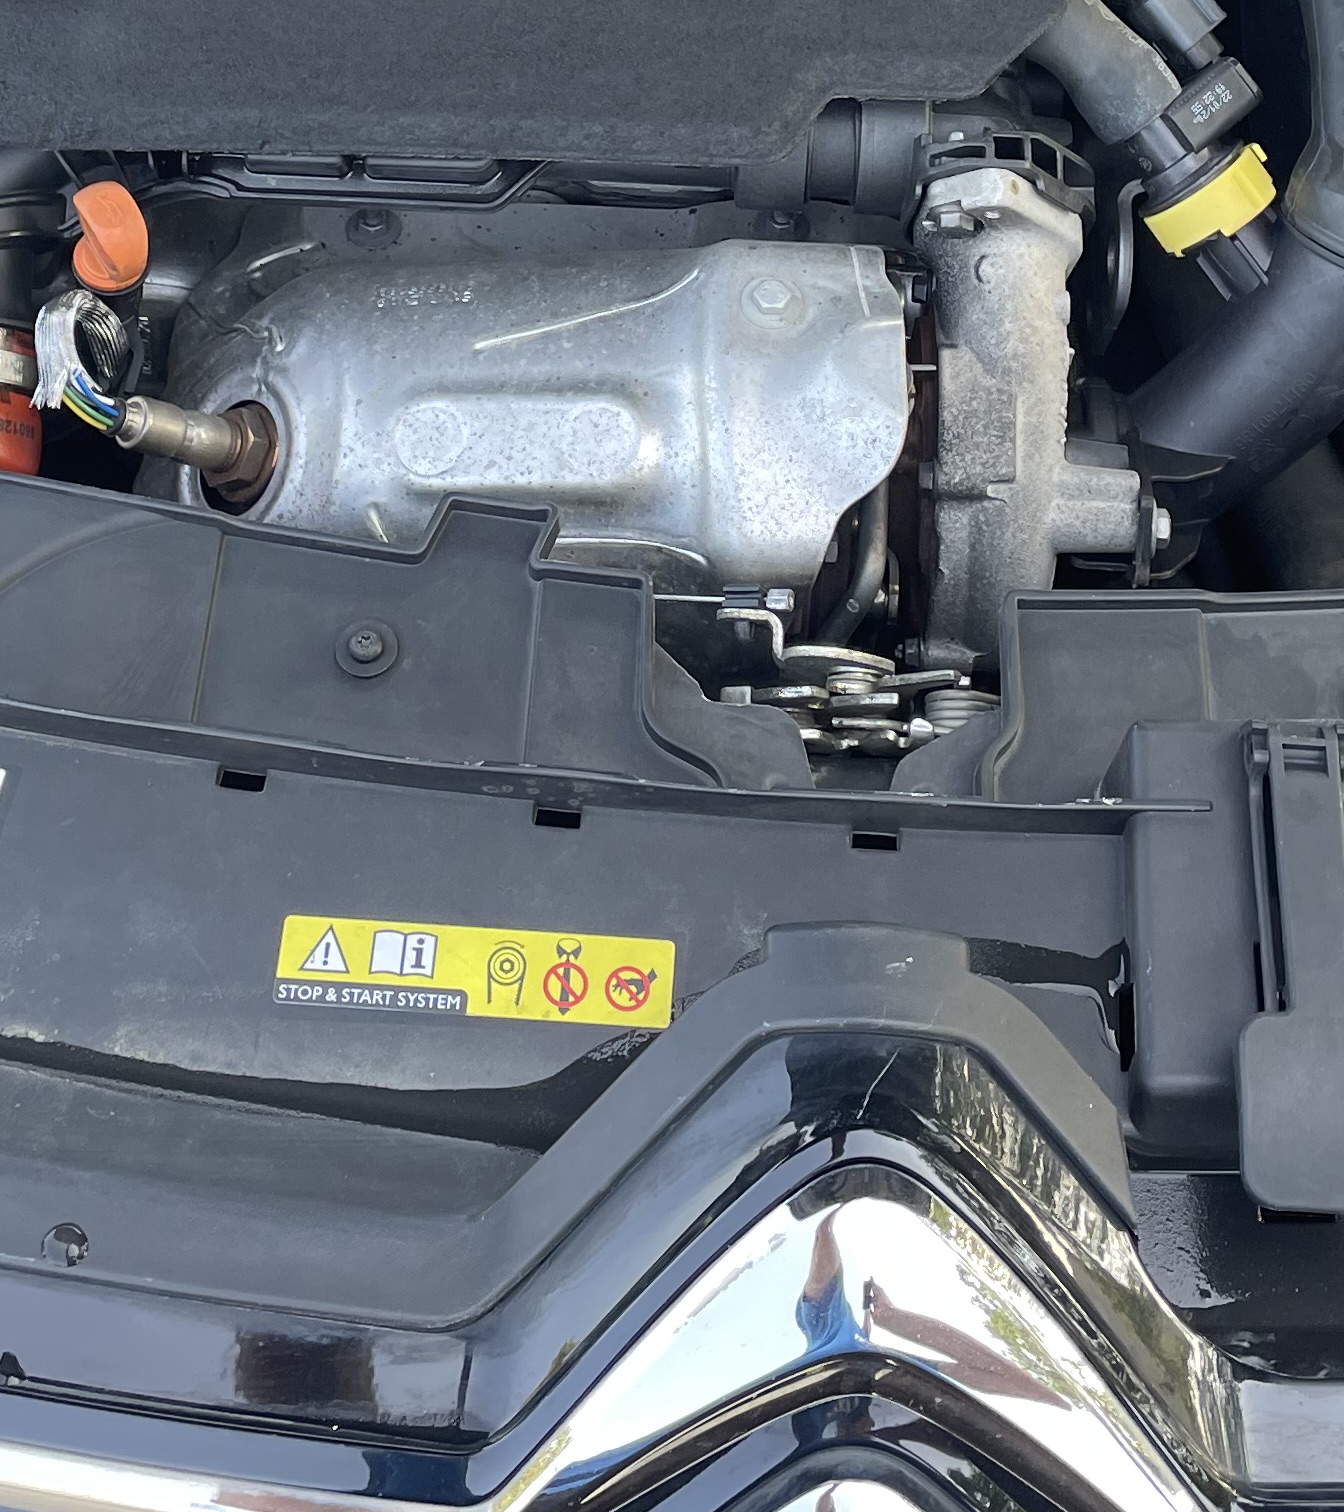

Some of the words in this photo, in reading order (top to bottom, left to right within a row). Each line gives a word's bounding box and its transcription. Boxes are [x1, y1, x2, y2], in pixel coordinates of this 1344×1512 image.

[277, 983, 324, 1002] STOP
[324, 987, 338, 1002] &
[341, 987, 395, 1006] START
[397, 990, 462, 1011] SYSTEM
